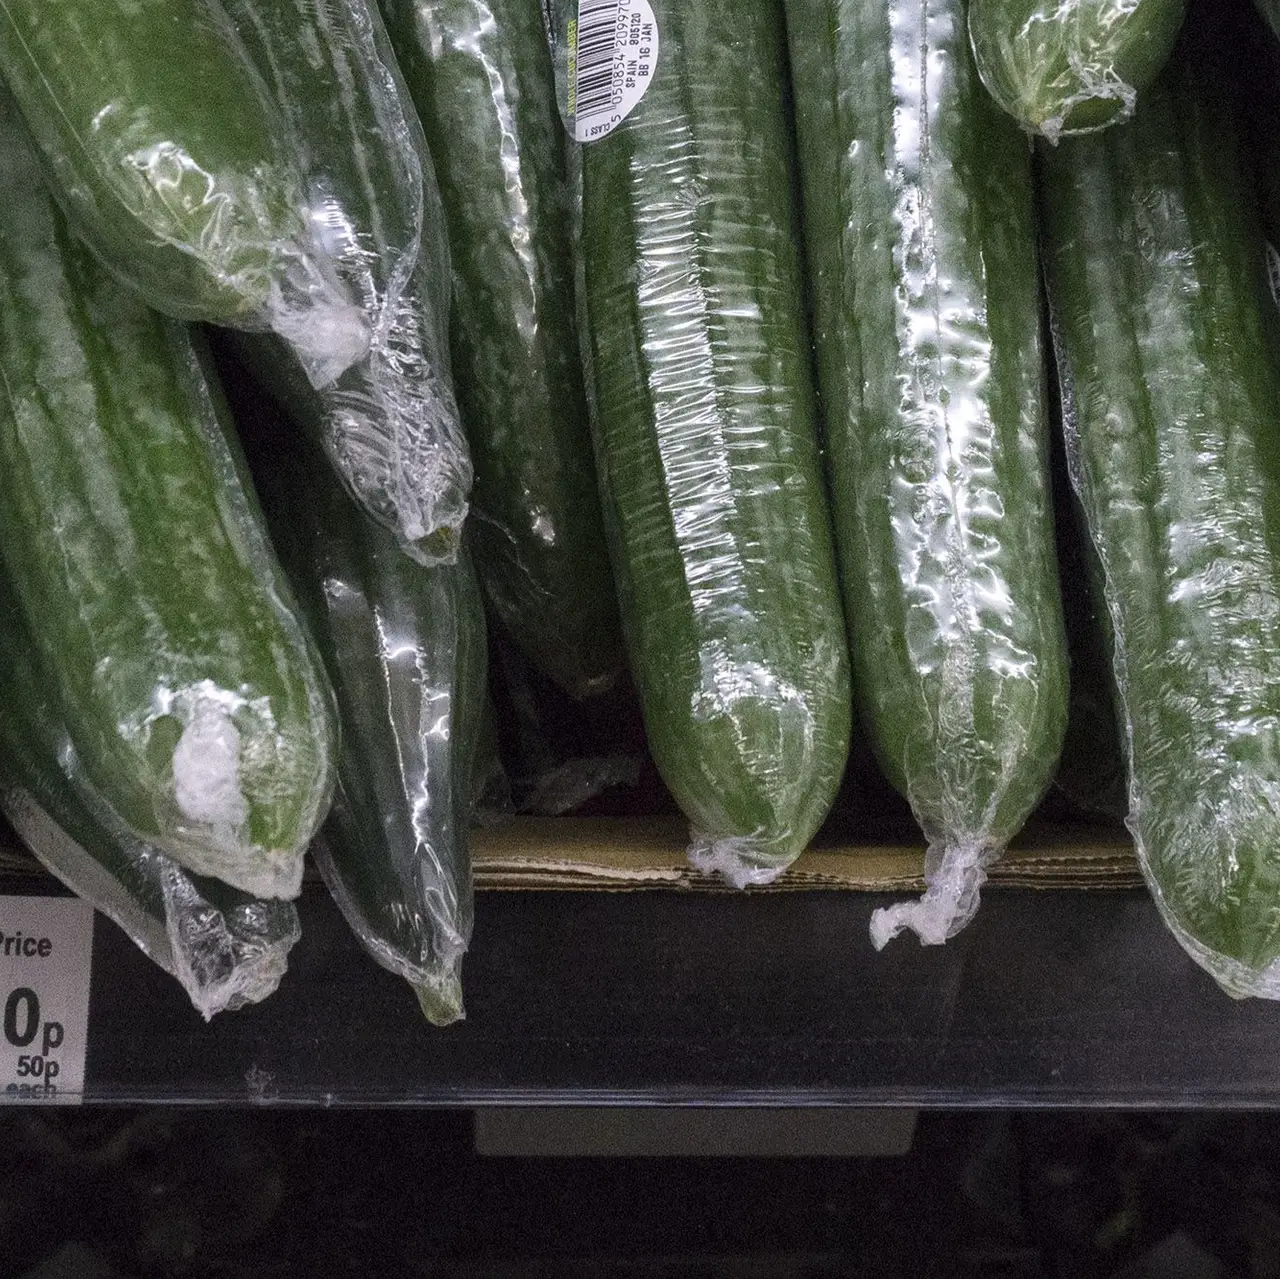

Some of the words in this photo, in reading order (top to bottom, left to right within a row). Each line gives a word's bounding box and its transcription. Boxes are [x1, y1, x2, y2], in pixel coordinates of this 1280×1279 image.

[640, 22, 653, 42] JAN
[567, 19, 577, 80] CUCUMBER
[639, 47, 651, 58] 16
[611, 53, 626, 106] 050854
[625, 59, 638, 89] SPAIN
[638, 64, 650, 77] BB
[589, 122, 611, 135] CLASS
[610, 114, 622, 123] 5
[16, 1054, 61, 1088] 50p
